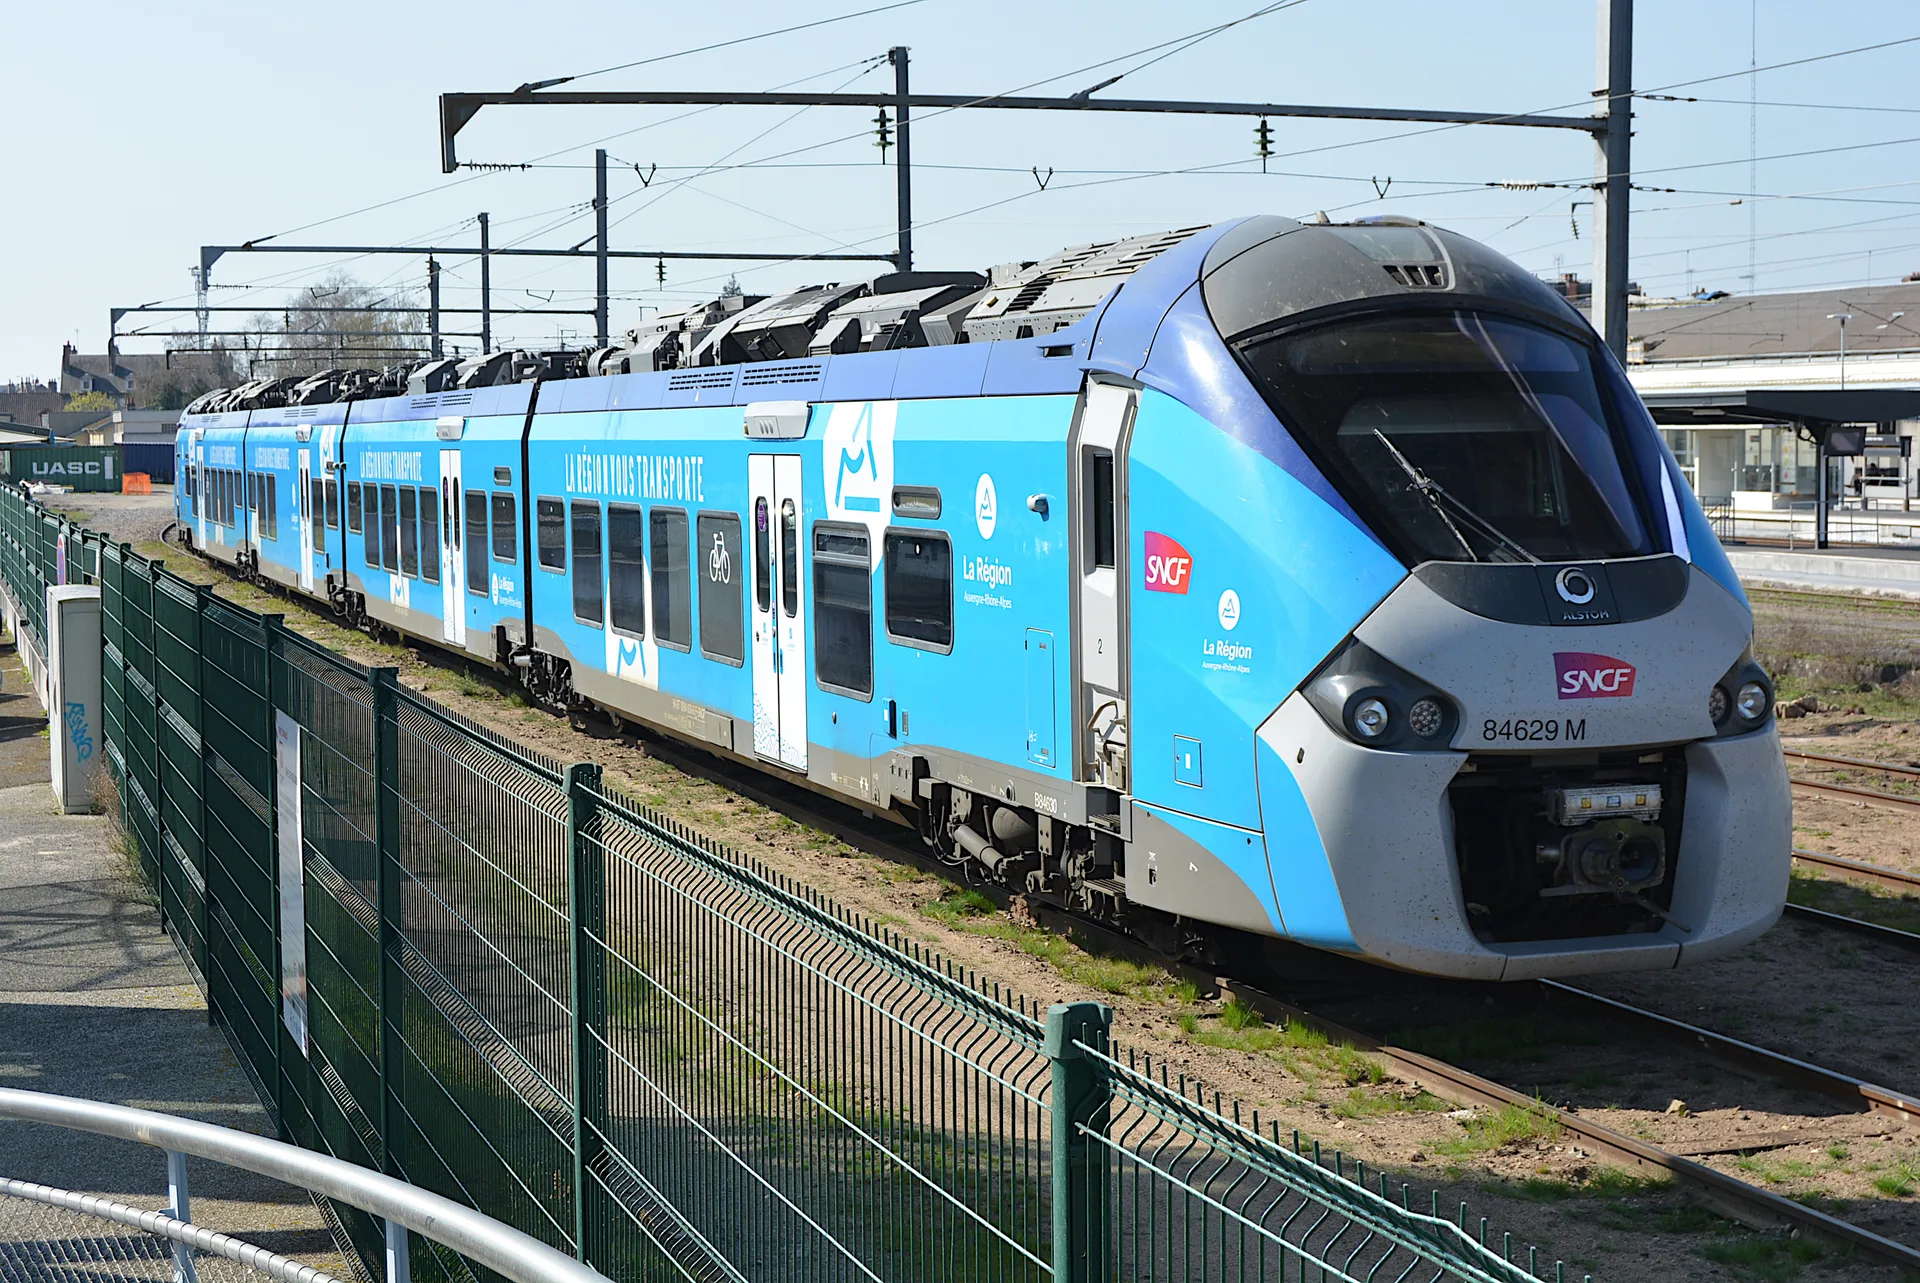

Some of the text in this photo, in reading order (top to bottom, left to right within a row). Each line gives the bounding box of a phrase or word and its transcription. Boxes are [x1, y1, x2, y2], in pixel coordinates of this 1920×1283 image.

[32, 462, 101, 475] UASC
[565, 444, 705, 503] LA RÉGION VOUS TRANSPORTE
[963, 554, 1013, 590] La Région
[1145, 554, 1190, 586] SNCF
[1563, 610, 1611, 621] ALSTOM
[1097, 637, 1104, 655] 2
[1203, 638, 1253, 661] La Région
[1560, 668, 1632, 694] SNCF
[1482, 718, 1587, 742] 84629 M
[1033, 791, 1059, 814] B84630
